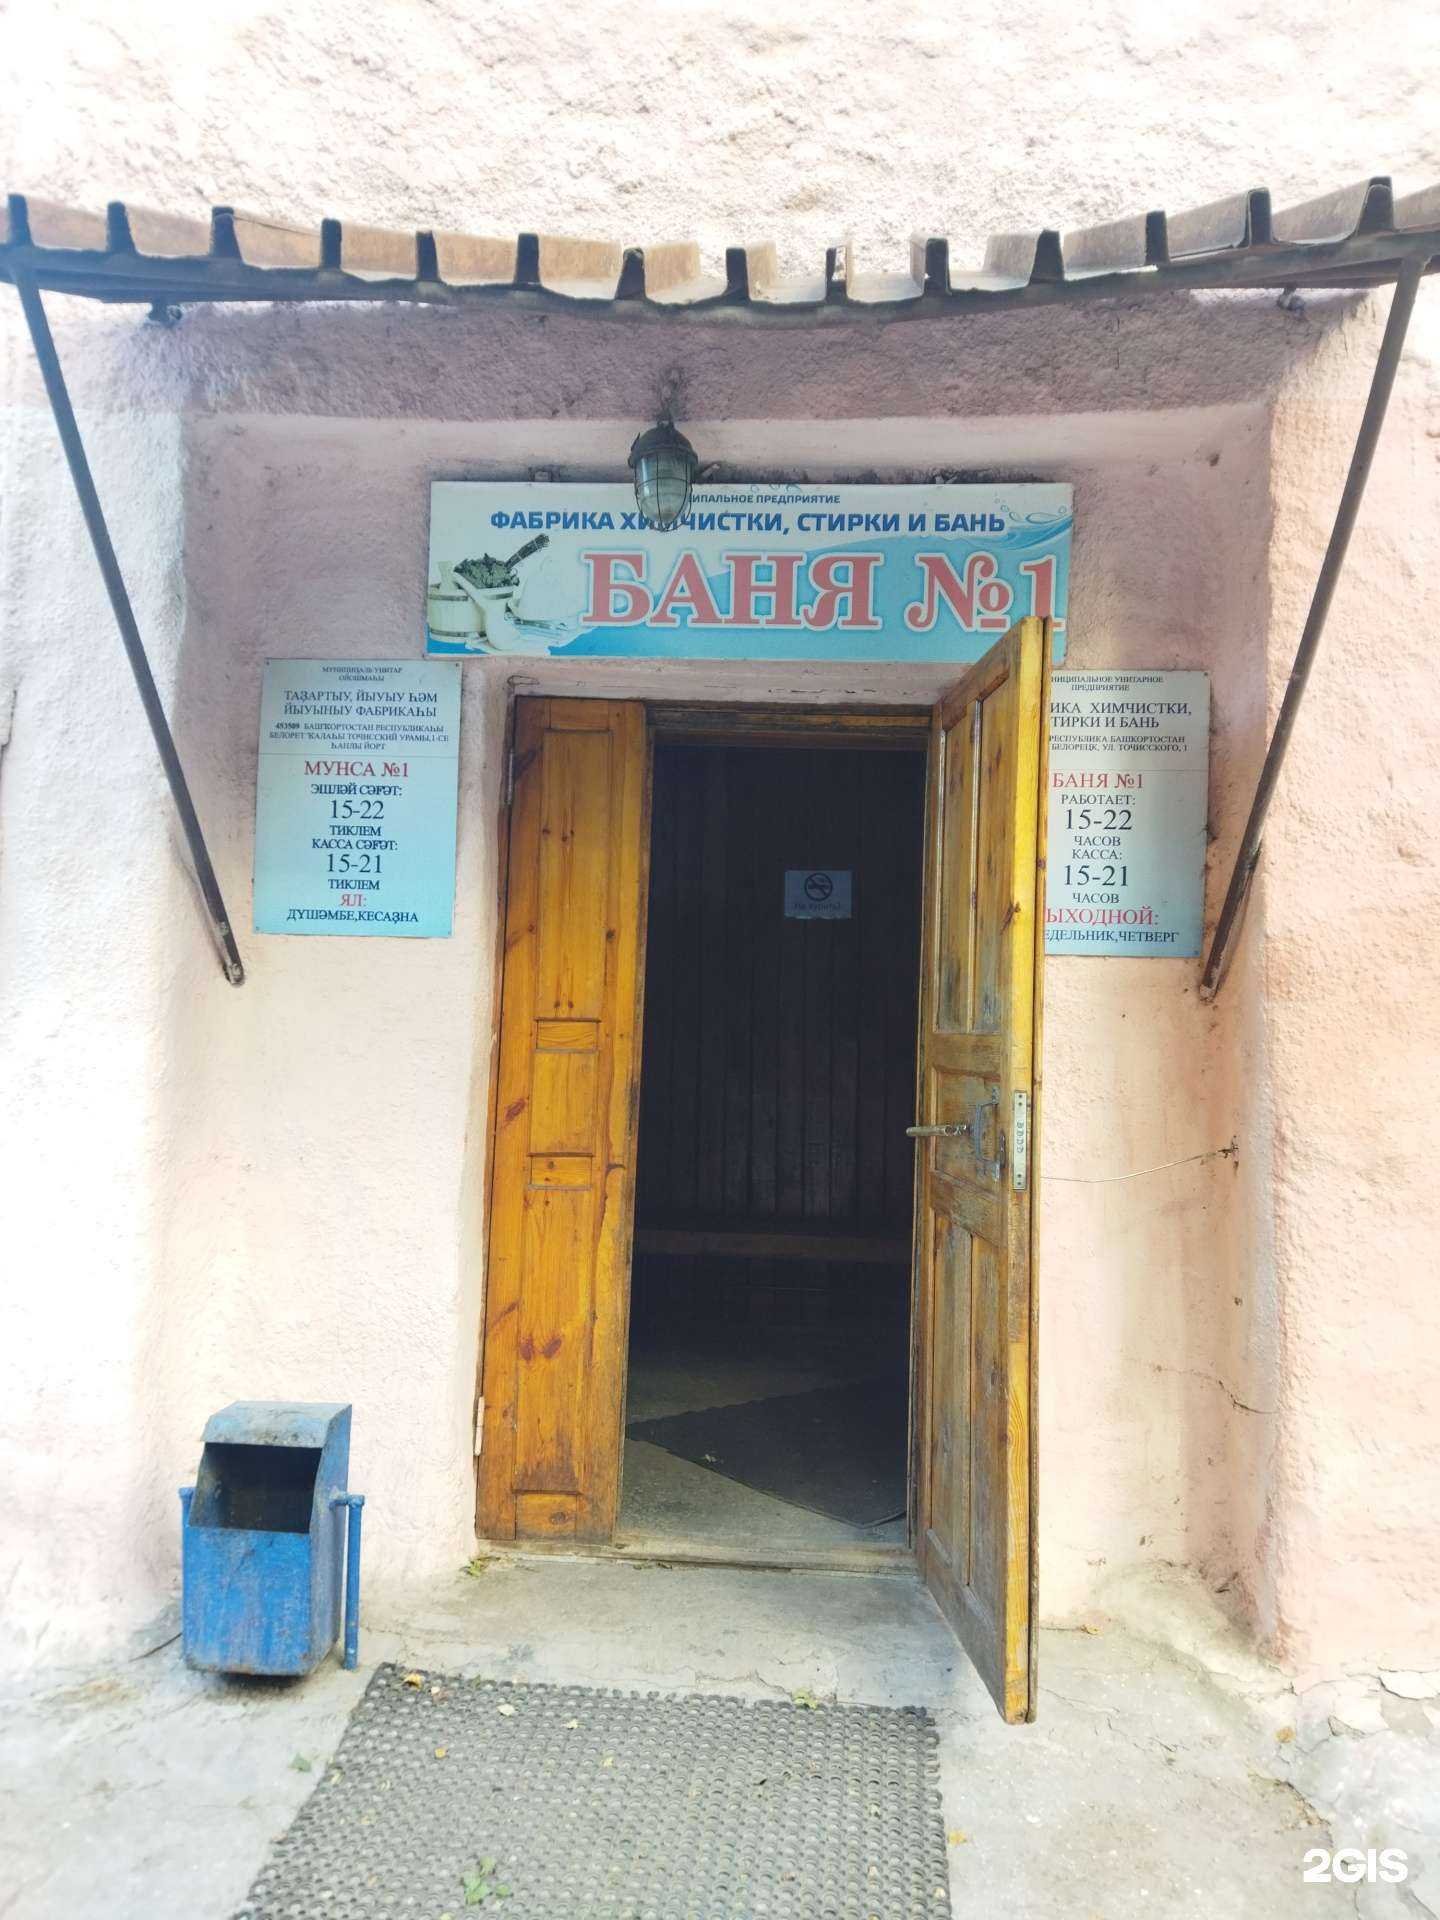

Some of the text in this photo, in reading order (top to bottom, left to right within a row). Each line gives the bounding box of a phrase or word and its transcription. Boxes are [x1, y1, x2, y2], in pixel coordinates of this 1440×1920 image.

[689, 494, 841, 505] ИПАЛЬНОЕ ПРЕДПРИЯТИЕ
[490, 511, 615, 530] ФАБРИКА
[797, 513, 900, 532] СТИРКИ
[909, 513, 926, 532] И
[934, 513, 1006, 533] БАНЬ
[582, 552, 1062, 629] БАНЯ №1
[1089, 702, 1192, 716] ХИМЧИСТКИ,
[1051, 716, 1160, 728] ТИРКИ И БАНЬ
[1110, 735, 1186, 743] БАШКОРТОСТАН
[303, 760, 410, 778] МУНСА №1
[1053, 773, 1144, 789] БАНЯ №1
[1061, 794, 1136, 806] РАБОТАЕТ:
[330, 800, 385, 820] 15-22
[1065, 809, 1133, 831] 15-22
[329, 825, 382, 837] ТИКЛЕМ
[311, 838, 353, 850] КАССА
[1074, 835, 1121, 847] ЧАСОВ
[1072, 849, 1123, 860] КАССА:
[327, 853, 383, 874] 15-21
[1064, 865, 1129, 887] 15-21
[328, 879, 381, 891] ТИКЛЕМ
[340, 893, 367, 907] ЯЛ:
[1072, 892, 1120, 904] ЧАСОВ
[1047, 905, 1160, 926] ЫХОДНОЙ:
[1045, 930, 1180, 943] ЕДЕЛЬНИК,ЧЕТВЕРГ
